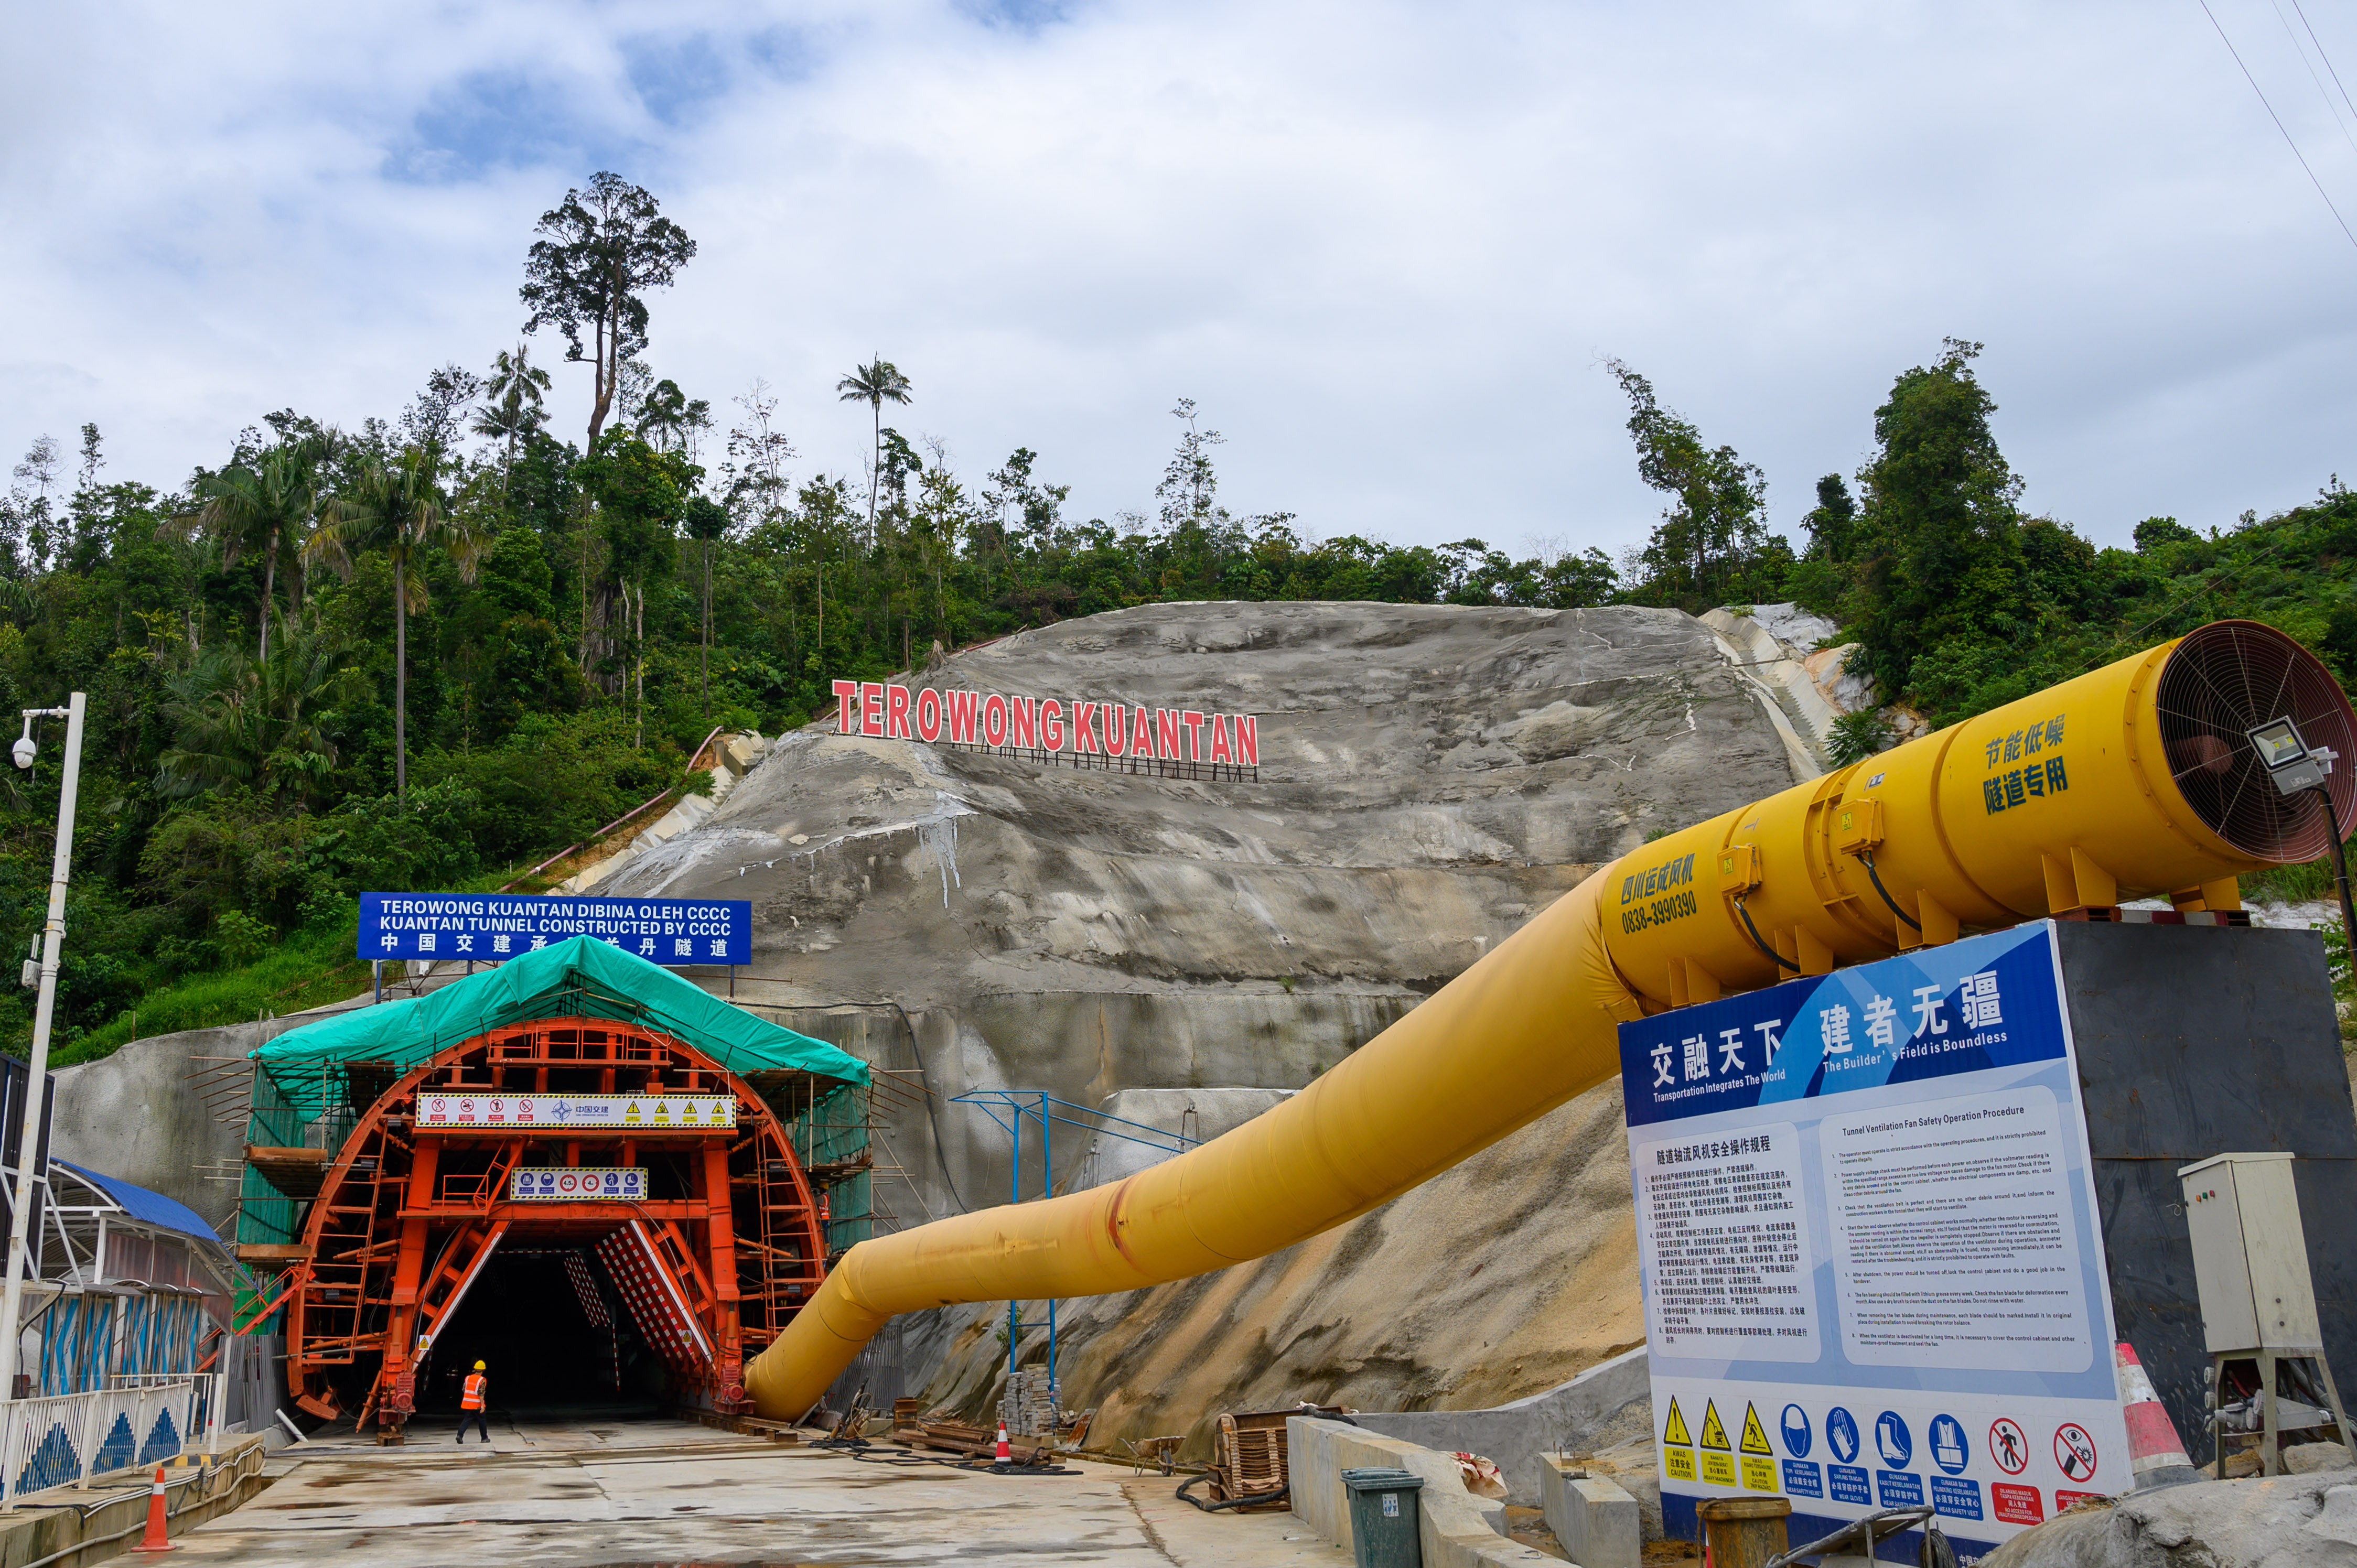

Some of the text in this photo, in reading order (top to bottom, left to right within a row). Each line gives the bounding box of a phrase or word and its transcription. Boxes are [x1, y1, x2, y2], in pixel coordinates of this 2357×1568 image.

[832, 679, 1259, 766] TEROWONG KUANTAN
[1985, 713, 2065, 770] 节能低噪
[1983, 755, 2068, 816] 隧道专用
[380, 916, 730, 935] KUANTAN TUNNEL CONSTRUCTED BY CCCC
[381, 901, 730, 920] TEROWONG KUANTAN DIBINA OLEH CCCC
[1622, 890, 1698, 934] 0838-3990390
[381, 933, 727, 956] 中国交建承关丹隧道
[1821, 970, 2003, 1056] 建者无疆
[1651, 1019, 1782, 1088] 交融天下
[1823, 1059, 1842, 1073] The
[1900, 1042, 1927, 1060] Field
[1930, 1042, 1939, 1054] is
[1943, 1030, 2007, 1052] Boundless
[1653, 1069, 1785, 1104] Transportation Integrates The World
[1843, 1107, 2024, 1136] Tunnel Ventilation Fan Safety Operation Procedure
[1656, 1134, 1771, 1165] 隧道轴流风机安全操作规程
[1670, 1458, 1691, 1469] 注意安全
[1671, 1469, 1692, 1478] CAUTION
[1892, 1481, 1920, 1490] KESELAMATAN
[1935, 1494, 1979, 1507] 必须穿安全背心
[1953, 1488, 1978, 1497] KESELAMATAN
